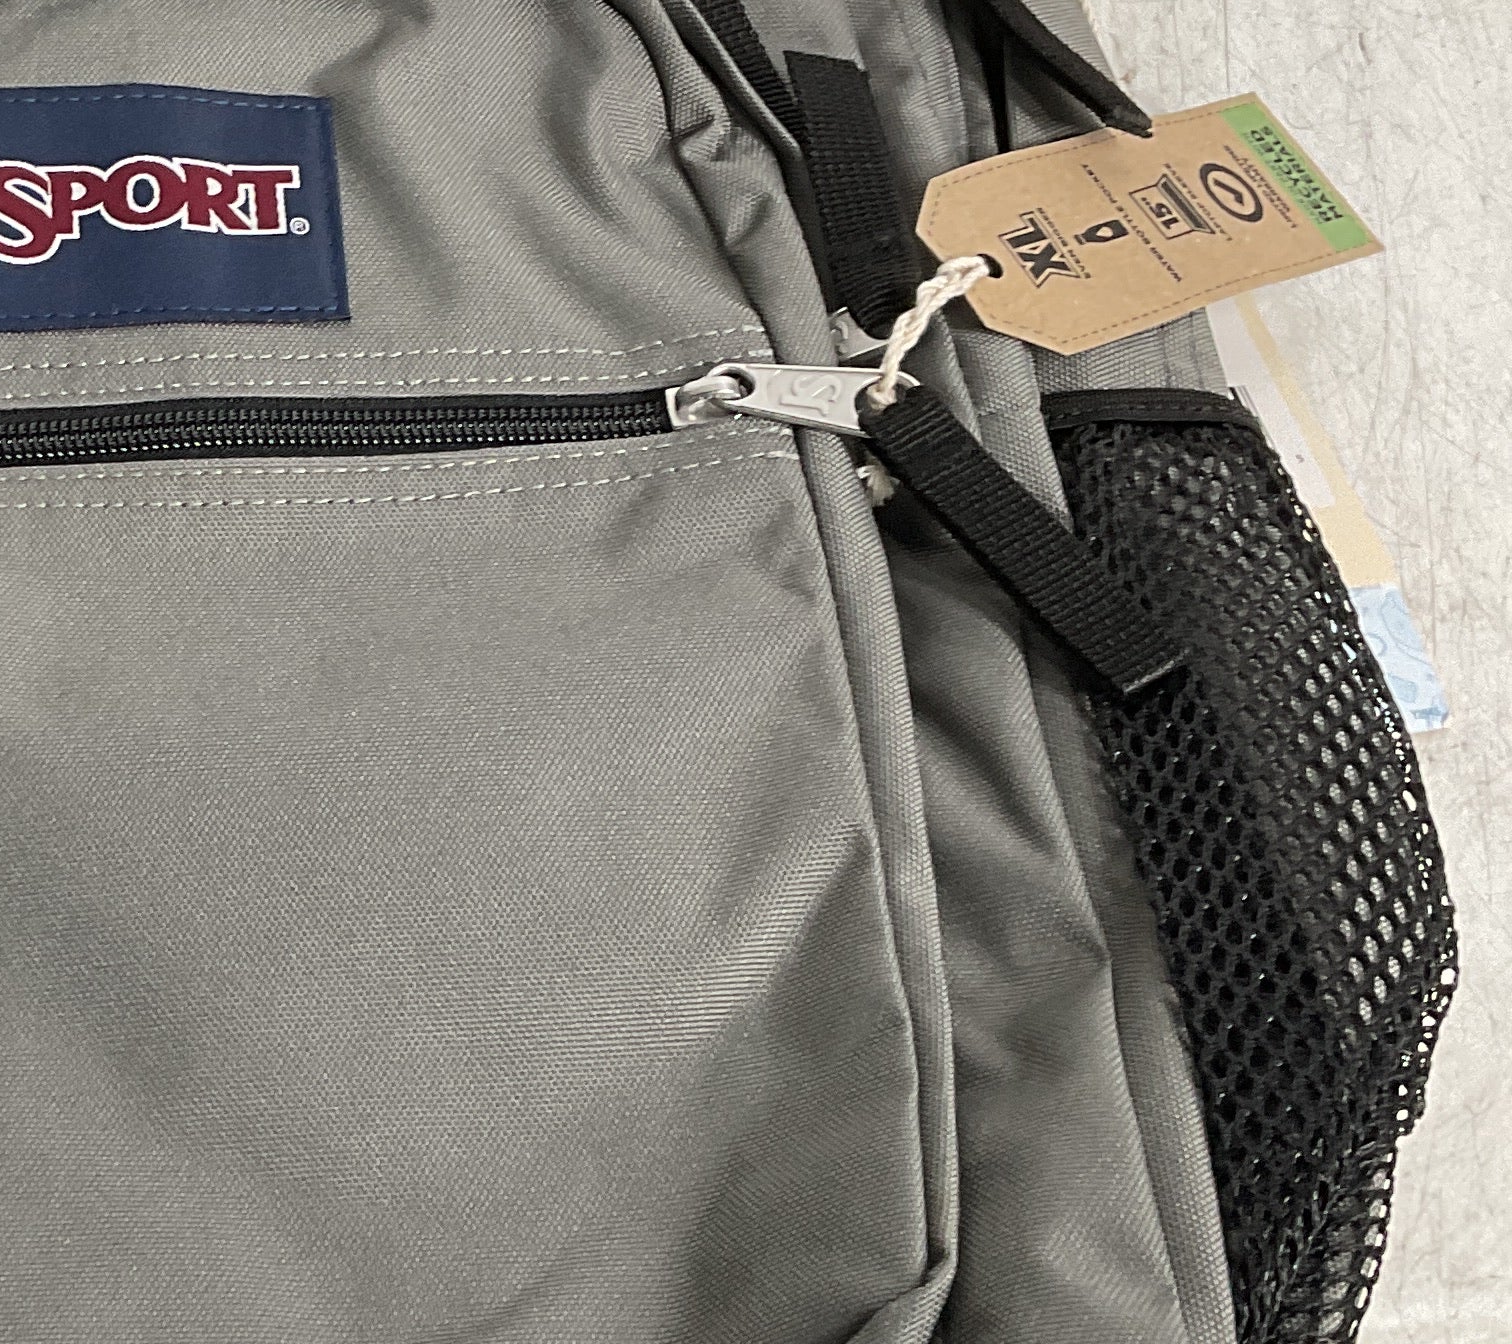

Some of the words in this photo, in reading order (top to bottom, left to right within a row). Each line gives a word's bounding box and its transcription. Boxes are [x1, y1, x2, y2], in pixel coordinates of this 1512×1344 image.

[1080, 162, 1118, 204] POCKET
[1162, 161, 1198, 200] SLEEVE
[1240, 156, 1292, 212] WARRANTY
[1247, 128, 1333, 223] RECYCLED
[1258, 125, 1344, 220] MATERIALS
[1036, 206, 1069, 247] BIGGER
[1114, 204, 1152, 245] BOTTLE
[1194, 200, 1233, 241] LAPTOP
[1260, 189, 1297, 229] LIMITED
[998, 210, 1081, 288] XL
[1065, 248, 1092, 280] EVEN
[1147, 246, 1184, 283] WATER
